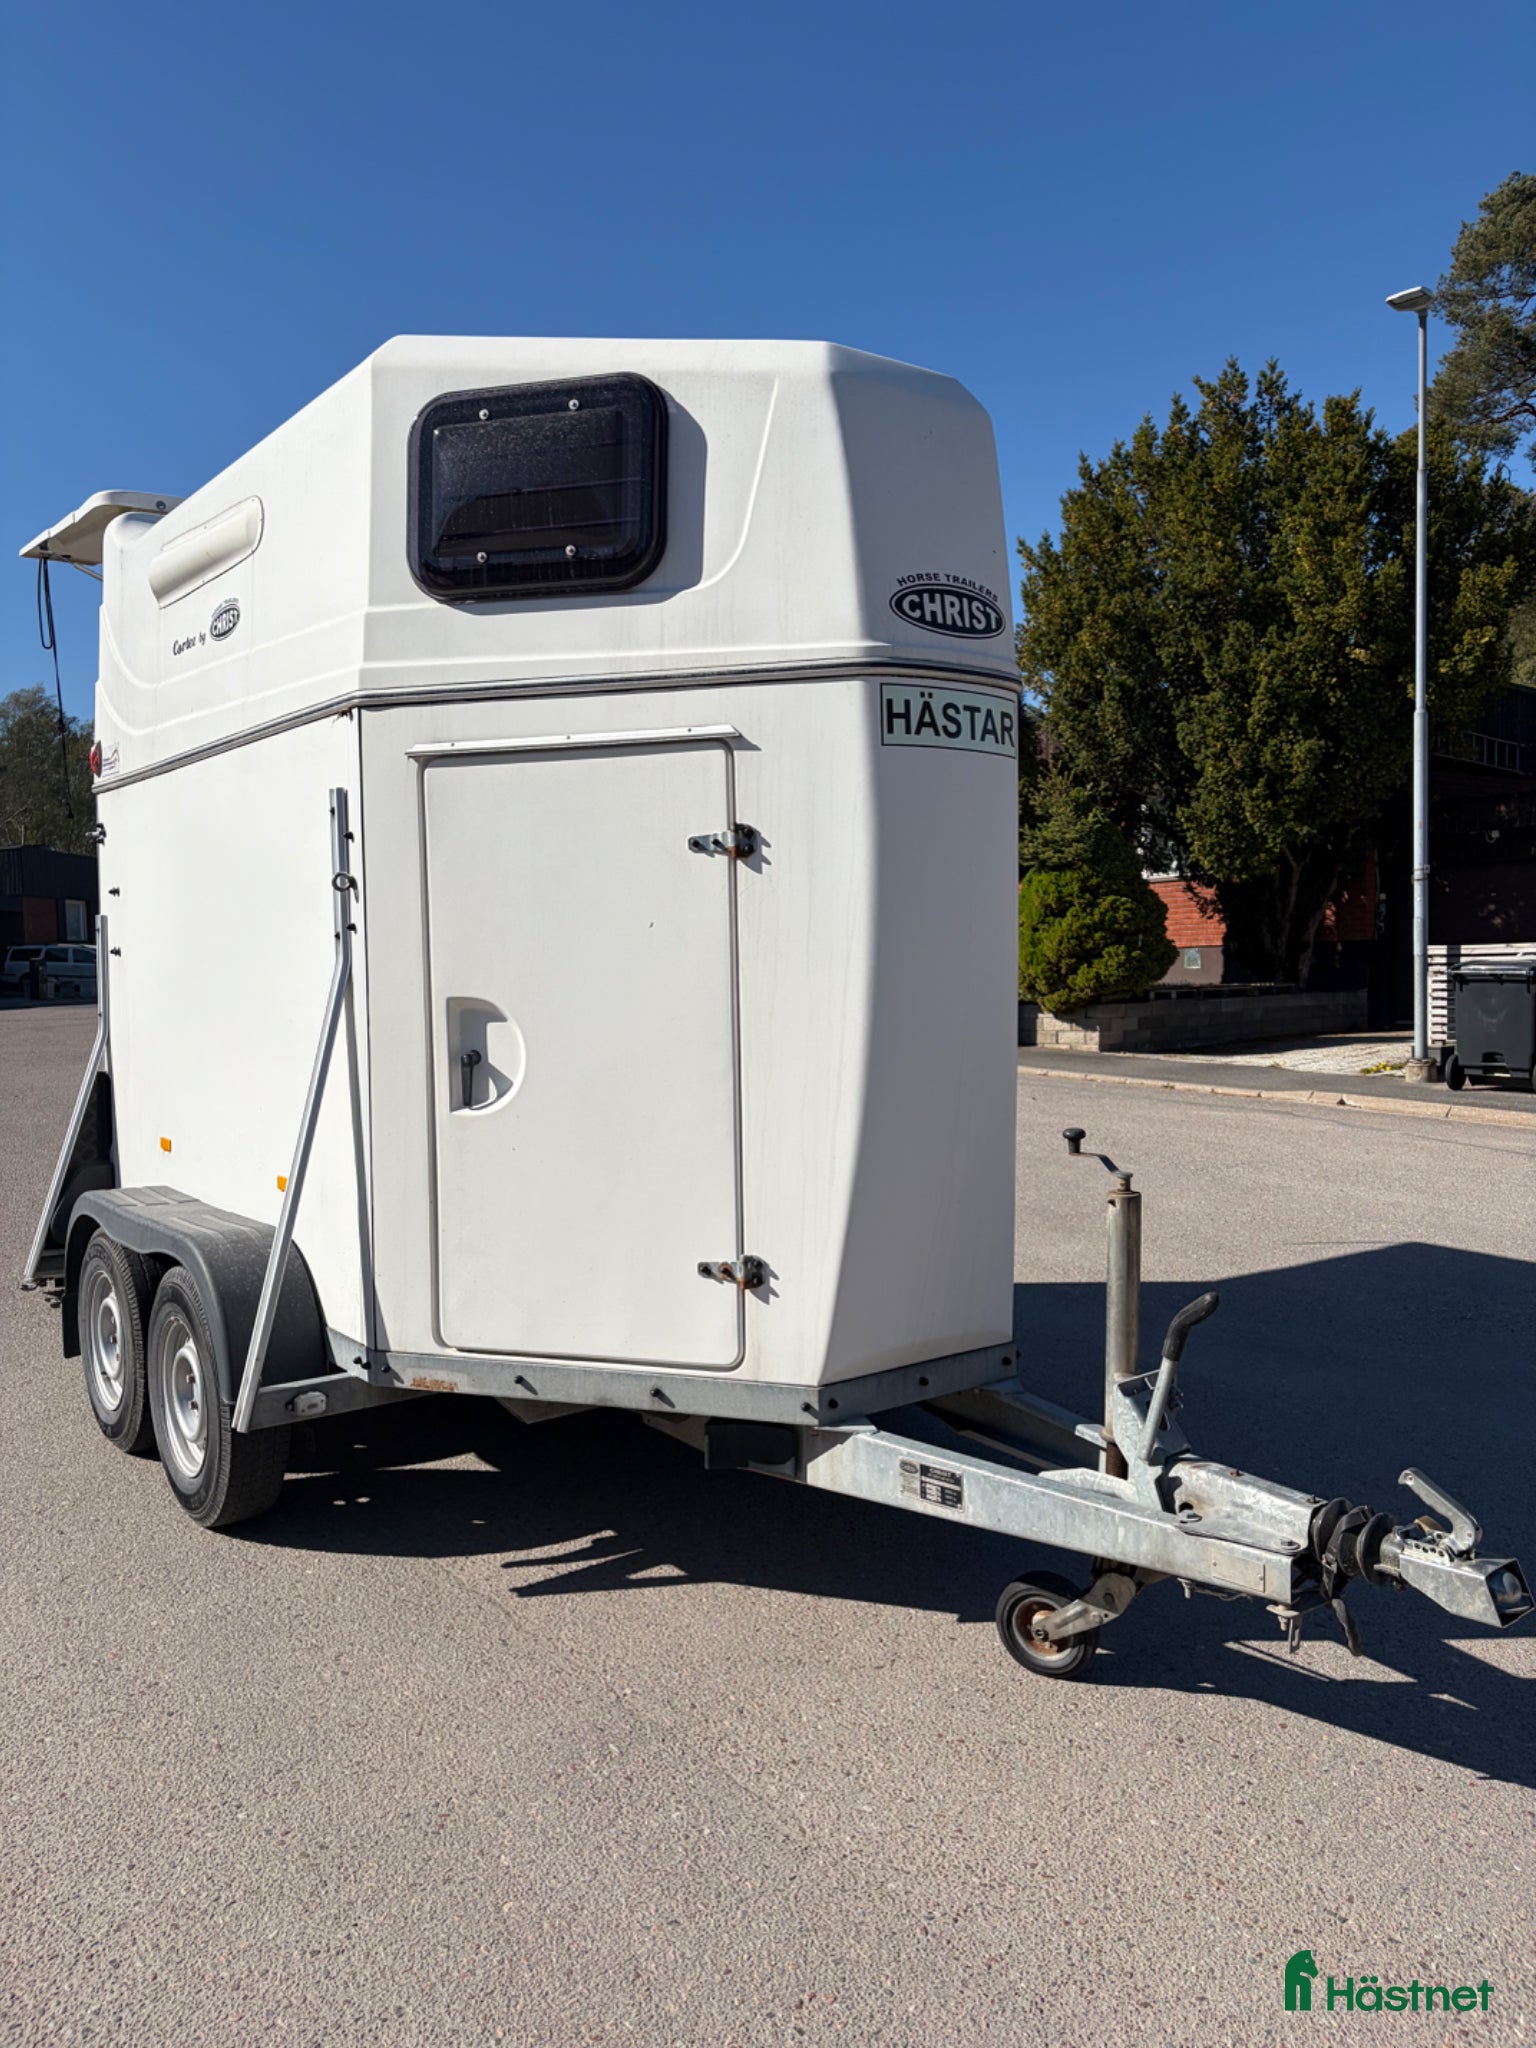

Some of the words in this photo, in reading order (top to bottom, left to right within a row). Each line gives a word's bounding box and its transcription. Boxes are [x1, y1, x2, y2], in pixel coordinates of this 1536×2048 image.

[896, 572, 941, 587] HORSE
[944, 573, 999, 602] TRAILERS
[901, 593, 998, 630] CHRIST
[886, 691, 1015, 748] HÄSTAR
